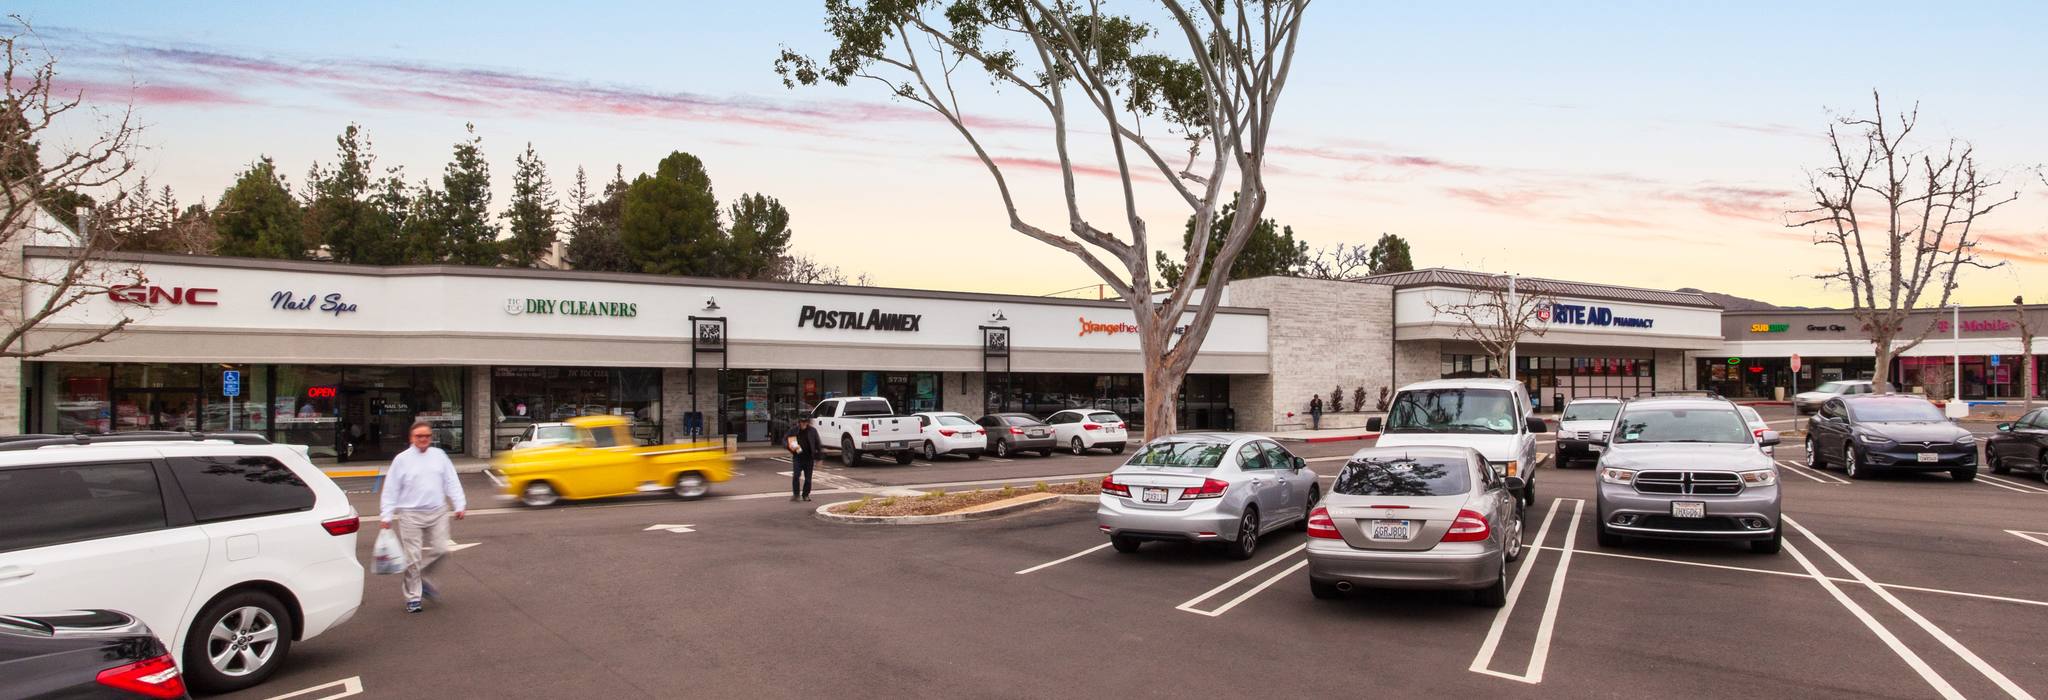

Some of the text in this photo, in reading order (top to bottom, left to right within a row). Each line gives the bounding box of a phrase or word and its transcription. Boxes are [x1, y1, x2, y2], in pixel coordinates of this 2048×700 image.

[108, 285, 218, 307] GNC
[271, 291, 357, 316] Nail Spa
[526, 298, 637, 318] DRY CLEANERS
[1552, 304, 1586, 324] RITE
[1586, 306, 1612, 326] AID
[1613, 317, 1654, 328] PHARMACY
[308, 387, 337, 398] OPEN
